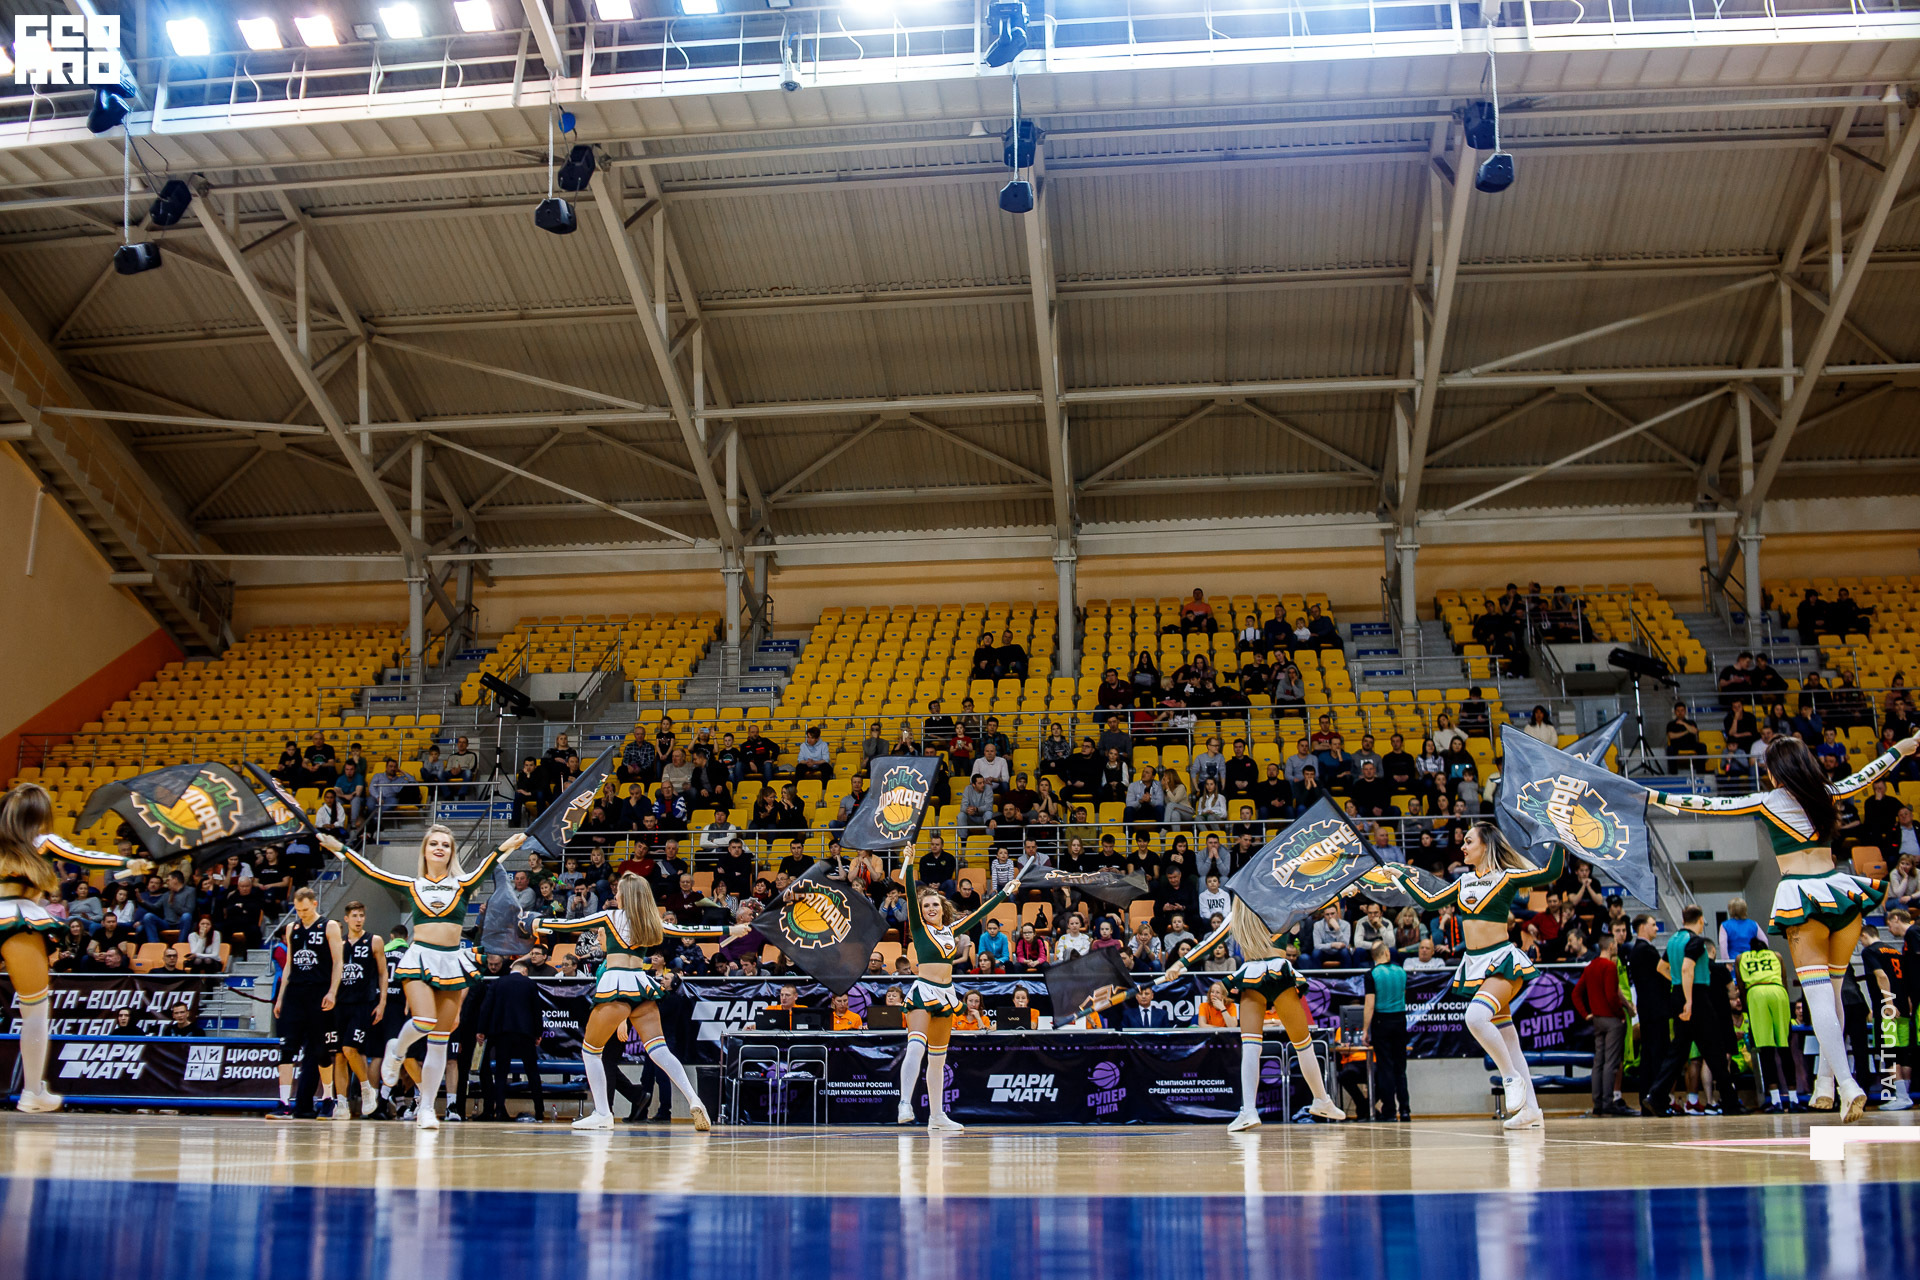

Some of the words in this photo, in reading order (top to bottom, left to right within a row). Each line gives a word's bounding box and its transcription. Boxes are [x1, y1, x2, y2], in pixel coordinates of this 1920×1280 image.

[309, 932, 324, 945] 35
[354, 946, 369, 958] 52
[1746, 960, 1773, 976] 98
[146, 991, 196, 1012] ДЛЯ
[543, 1021, 579, 1029] КОМАНД
[1428, 1024, 1463, 1032] 2019/20
[1520, 1011, 1575, 1038] СУПЕР
[325, 1031, 339, 1044] 35
[353, 1029, 366, 1043] 52
[1534, 1031, 1565, 1049] ЛИГА
[58, 1043, 146, 1061] ПАРИ
[58, 1062, 147, 1080] МАТЧ
[986, 1074, 1055, 1088] ПАРИ
[921, 1089, 960, 1107] СЕР
[990, 1088, 1059, 1102] МАТЧ
[1087, 1088, 1127, 1107] СУПЕР
[1096, 1103, 1118, 1115] ЛИГА
